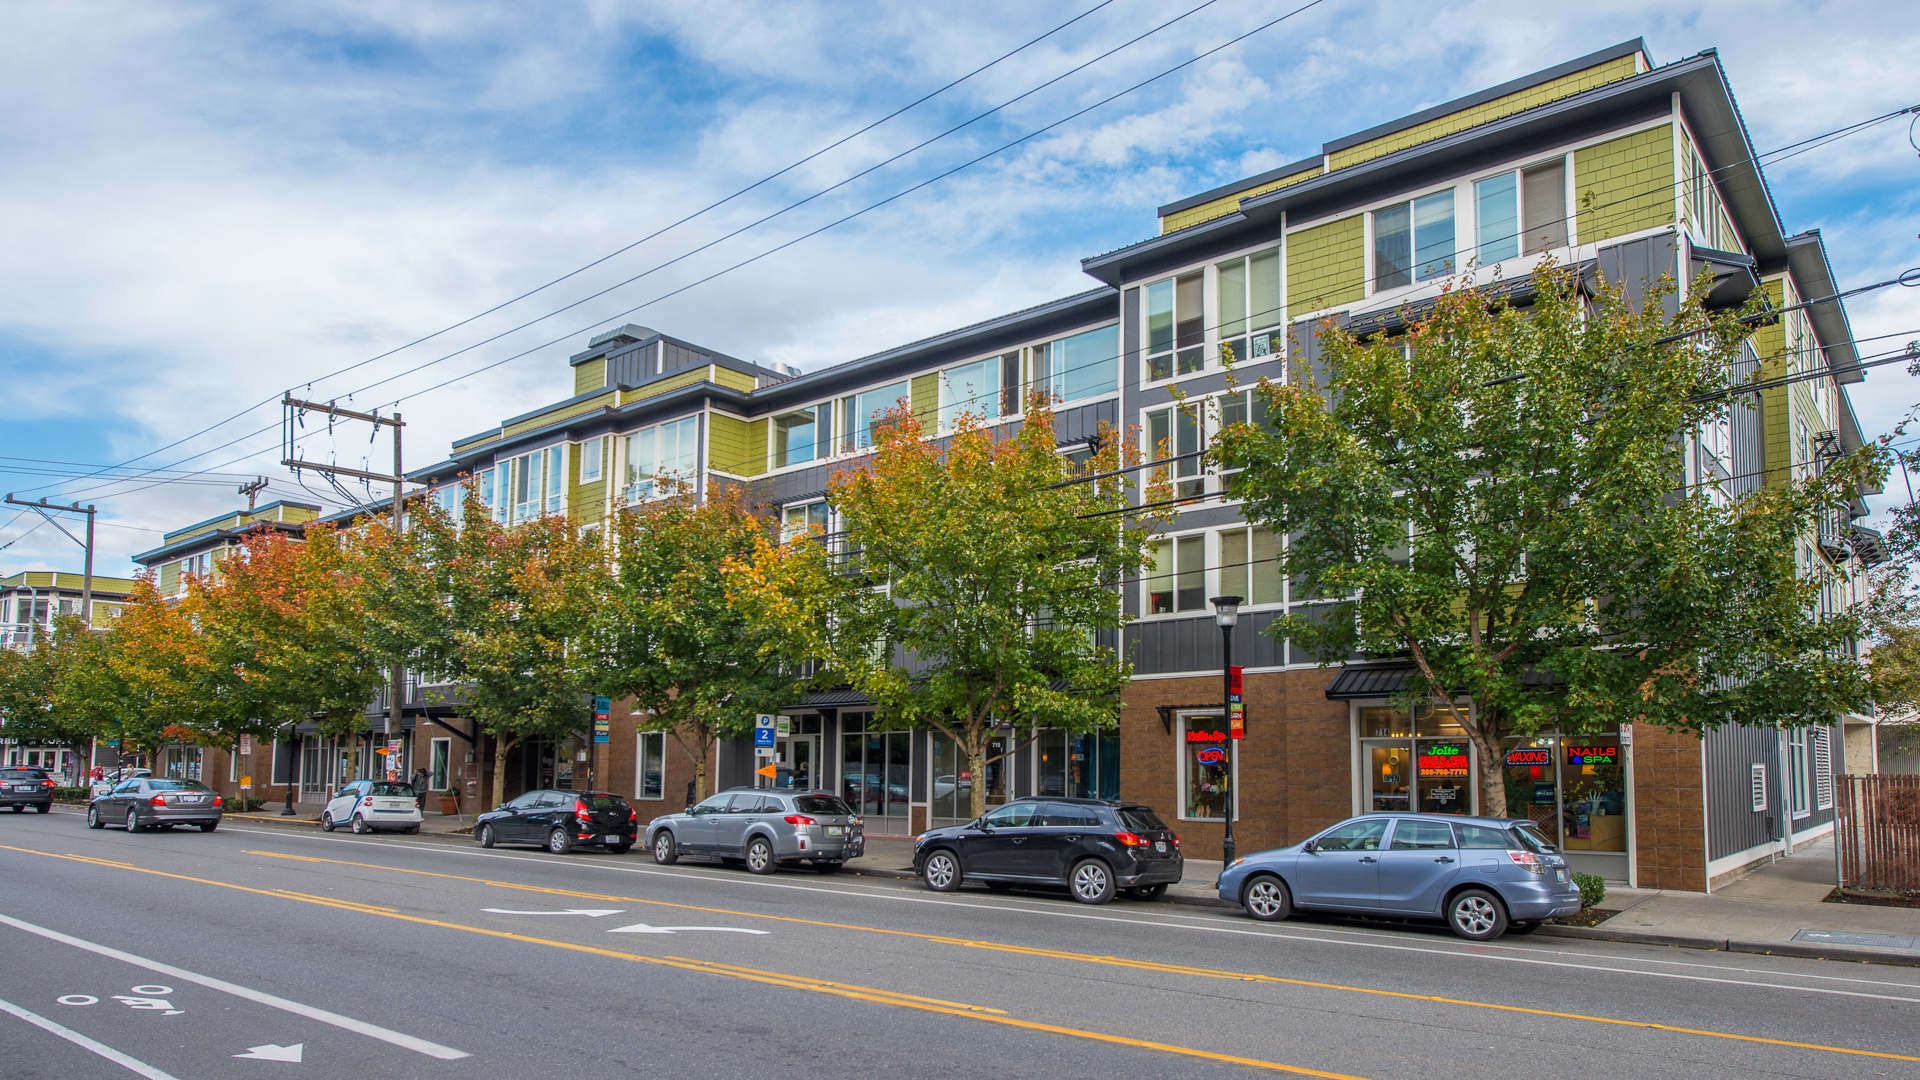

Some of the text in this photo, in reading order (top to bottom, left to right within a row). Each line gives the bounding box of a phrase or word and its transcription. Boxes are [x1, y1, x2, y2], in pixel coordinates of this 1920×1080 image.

[762, 730, 768, 739] 2
[1427, 746, 1459, 755] Jolie
[1569, 747, 1616, 756] NAILS
[1198, 751, 1224, 761] OPEN
[1508, 752, 1547, 762] WAXING
[1573, 756, 1582, 764] &
[1384, 774, 1400, 782] OPEN
